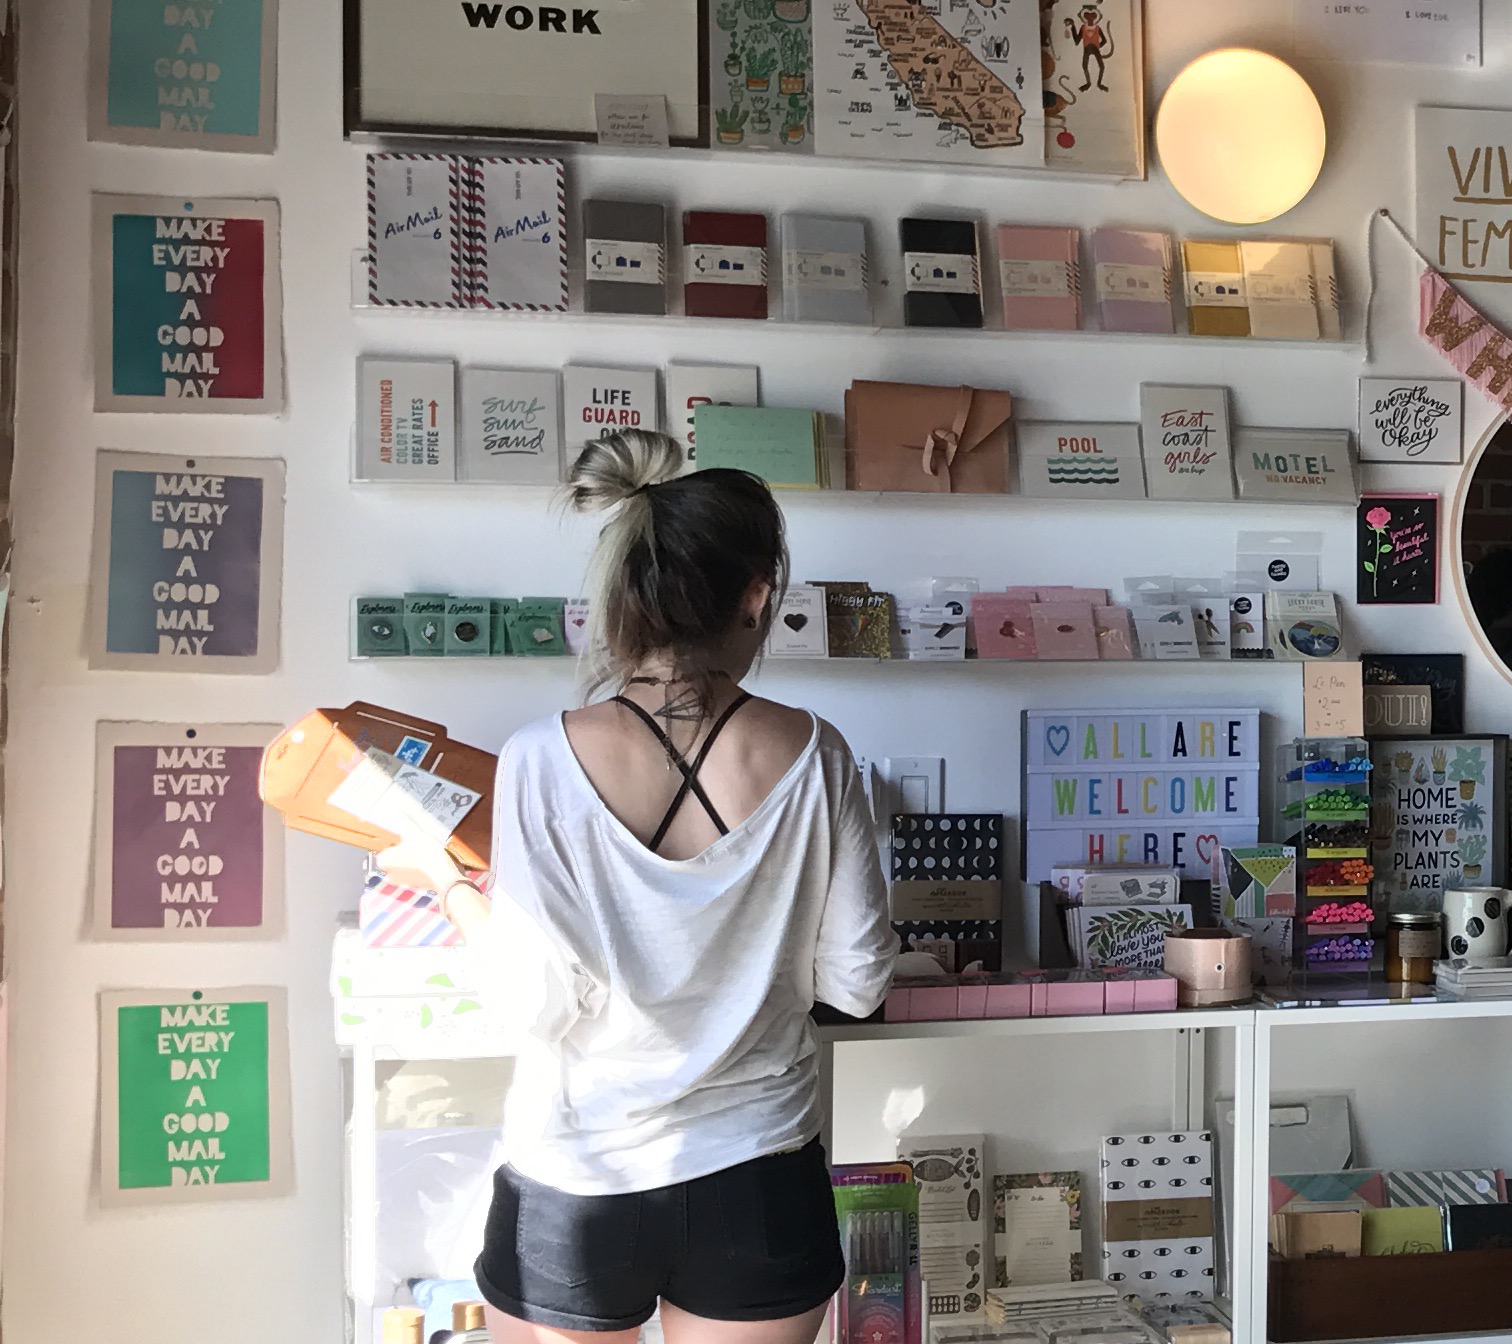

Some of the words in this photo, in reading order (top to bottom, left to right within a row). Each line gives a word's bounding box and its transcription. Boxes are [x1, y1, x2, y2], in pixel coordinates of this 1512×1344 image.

[164, 5, 215, 29] DAY
[461, 2, 602, 35] WORK
[178, 33, 198, 54] A
[154, 58, 220, 82] GOOD
[158, 86, 215, 110] MAIL
[160, 110, 208, 132] DAY
[156, 217, 225, 241] MAKE
[152, 244, 230, 268] EVERY
[166, 271, 216, 294] DAY
[180, 299, 201, 320] A
[158, 325, 225, 347] GOOD
[162, 352, 219, 374] MAIL
[165, 378, 213, 398] DAY
[592, 388, 632, 406] LIFE
[381, 379, 393, 444] CONDITIONED
[1369, 386, 1451, 418] everything
[396, 417, 408, 428] TV
[412, 398, 424, 430] RATES
[482, 416, 538, 433] sun
[582, 407, 641, 426] GUARD
[1161, 410, 1214, 428] East
[1375, 407, 1411, 430] will
[1414, 405, 1436, 430] be
[1058, 436, 1103, 454] POOL
[1162, 425, 1216, 447] coast
[381, 447, 393, 464] AIR
[396, 430, 408, 465] COLOR
[412, 435, 424, 465] GREAT
[427, 431, 439, 465] OFFICE
[1164, 447, 1217, 474] girls
[1252, 452, 1335, 475] MOTEL
[155, 474, 225, 498] MAKE
[1266, 475, 1280, 483] NO
[1283, 476, 1327, 485] VACANCY
[152, 501, 229, 525] EVERY
[163, 528, 214, 551] DAY
[176, 556, 197, 577] A
[153, 581, 220, 604] GOOD
[157, 608, 214, 631] MAIL
[159, 635, 208, 655] DAY
[1083, 721, 1153, 759] ALL
[1172, 720, 1242, 758] ARE
[156, 748, 226, 768] MAKE
[153, 774, 230, 796] EVERY
[1053, 776, 1239, 816] WELCOME
[1398, 787, 1457, 811] HOME
[166, 801, 216, 822] DAY
[1396, 814, 1409, 826] IS
[1412, 813, 1458, 826] WHERE
[180, 828, 200, 849] A
[1088, 831, 1187, 868] HERE
[1411, 829, 1444, 848] MY
[157, 854, 223, 875] GOOD
[1393, 851, 1460, 871] PLANTS
[161, 881, 218, 903] MAIL
[1409, 873, 1441, 890] ARE
[164, 909, 212, 928] DAY
[1122, 922, 1160, 941] ALMOST
[1108, 940, 1140, 960] love
[1114, 952, 1142, 967] MORE
[161, 1005, 229, 1027] MAKE
[158, 1031, 235, 1054] EVERY
[170, 1059, 221, 1081] DAY
[185, 1086, 207, 1107] A
[163, 1112, 230, 1134] GOOD
[168, 1138, 226, 1162] MAIL
[171, 1165, 220, 1186] DAY
[908, 1212, 918, 1243] GELLY
